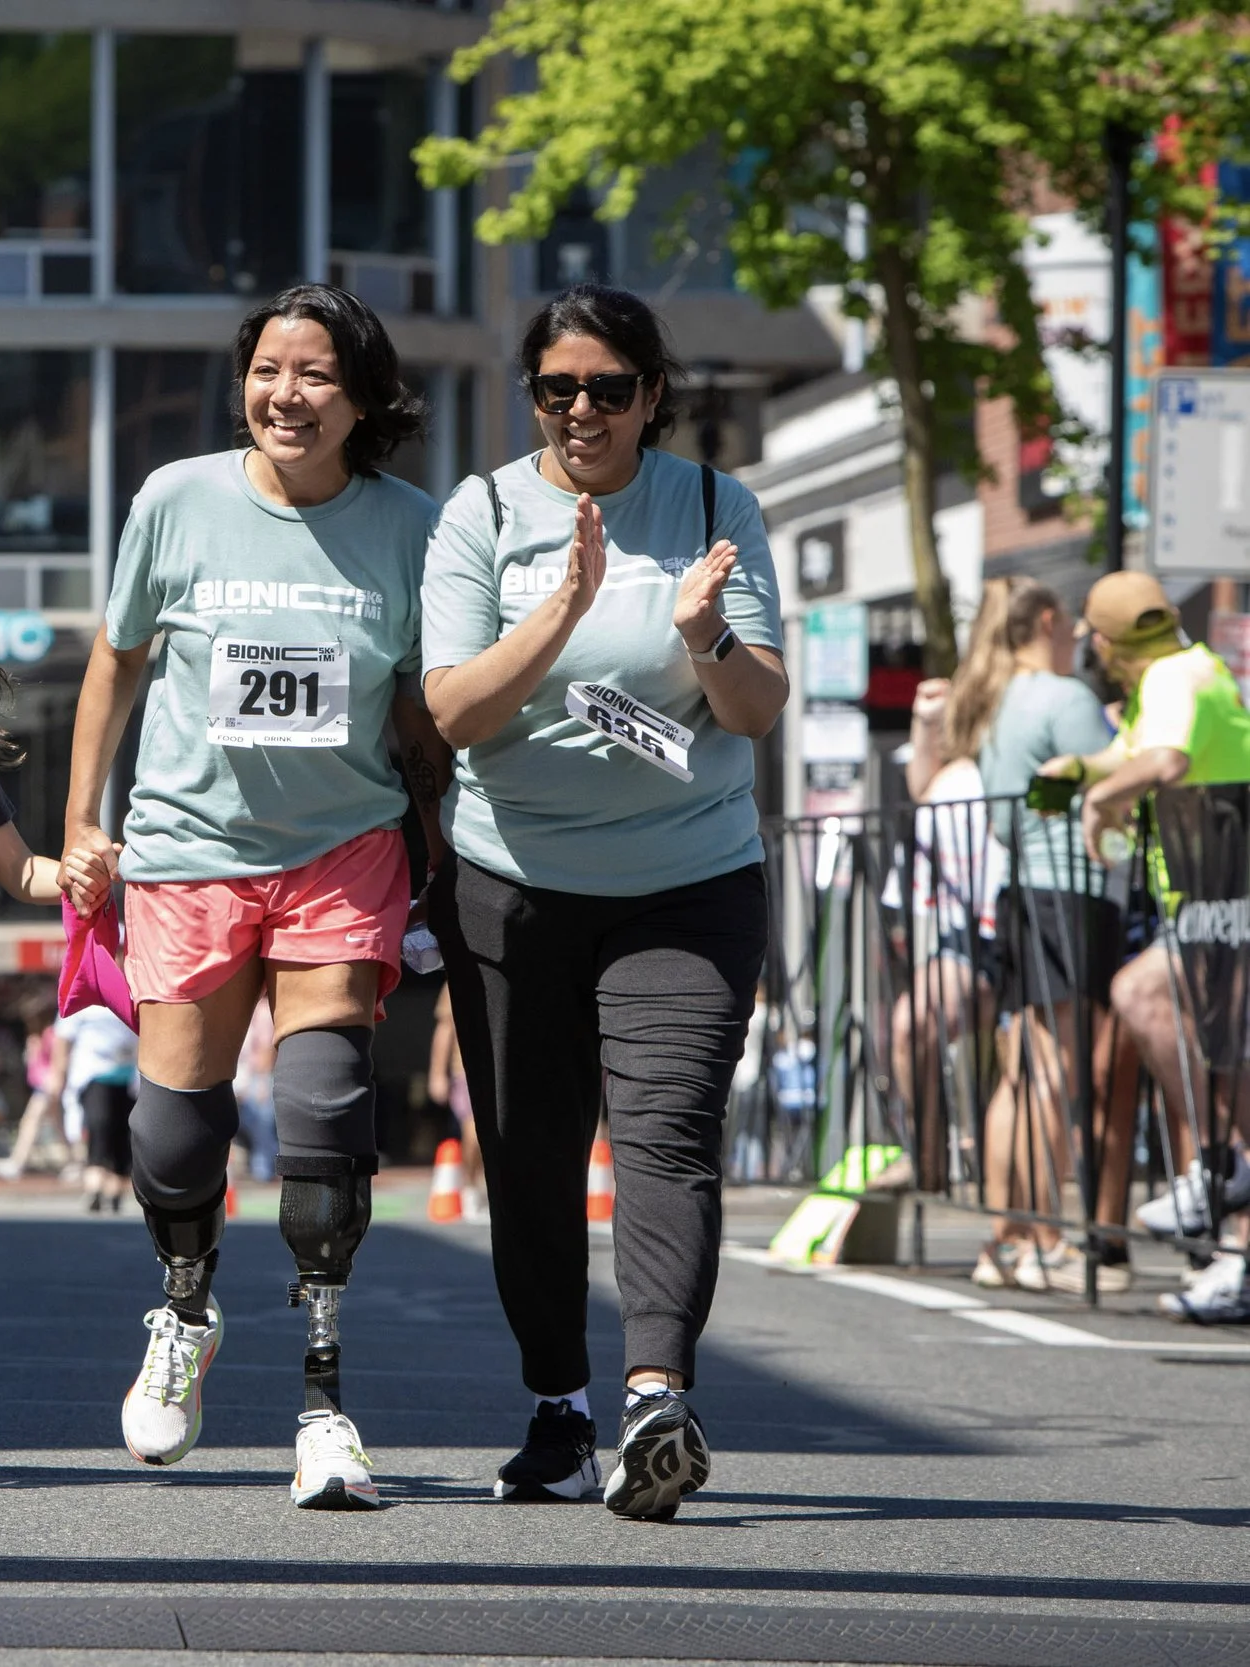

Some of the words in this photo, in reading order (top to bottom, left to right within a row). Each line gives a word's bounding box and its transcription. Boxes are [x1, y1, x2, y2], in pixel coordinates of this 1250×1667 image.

[194, 579, 355, 615] BIONIC
[227, 643, 318, 662] BIONIC
[239, 669, 320, 717] 291
[584, 684, 665, 734] BIONIC
[217, 735, 244, 743] FOOD
